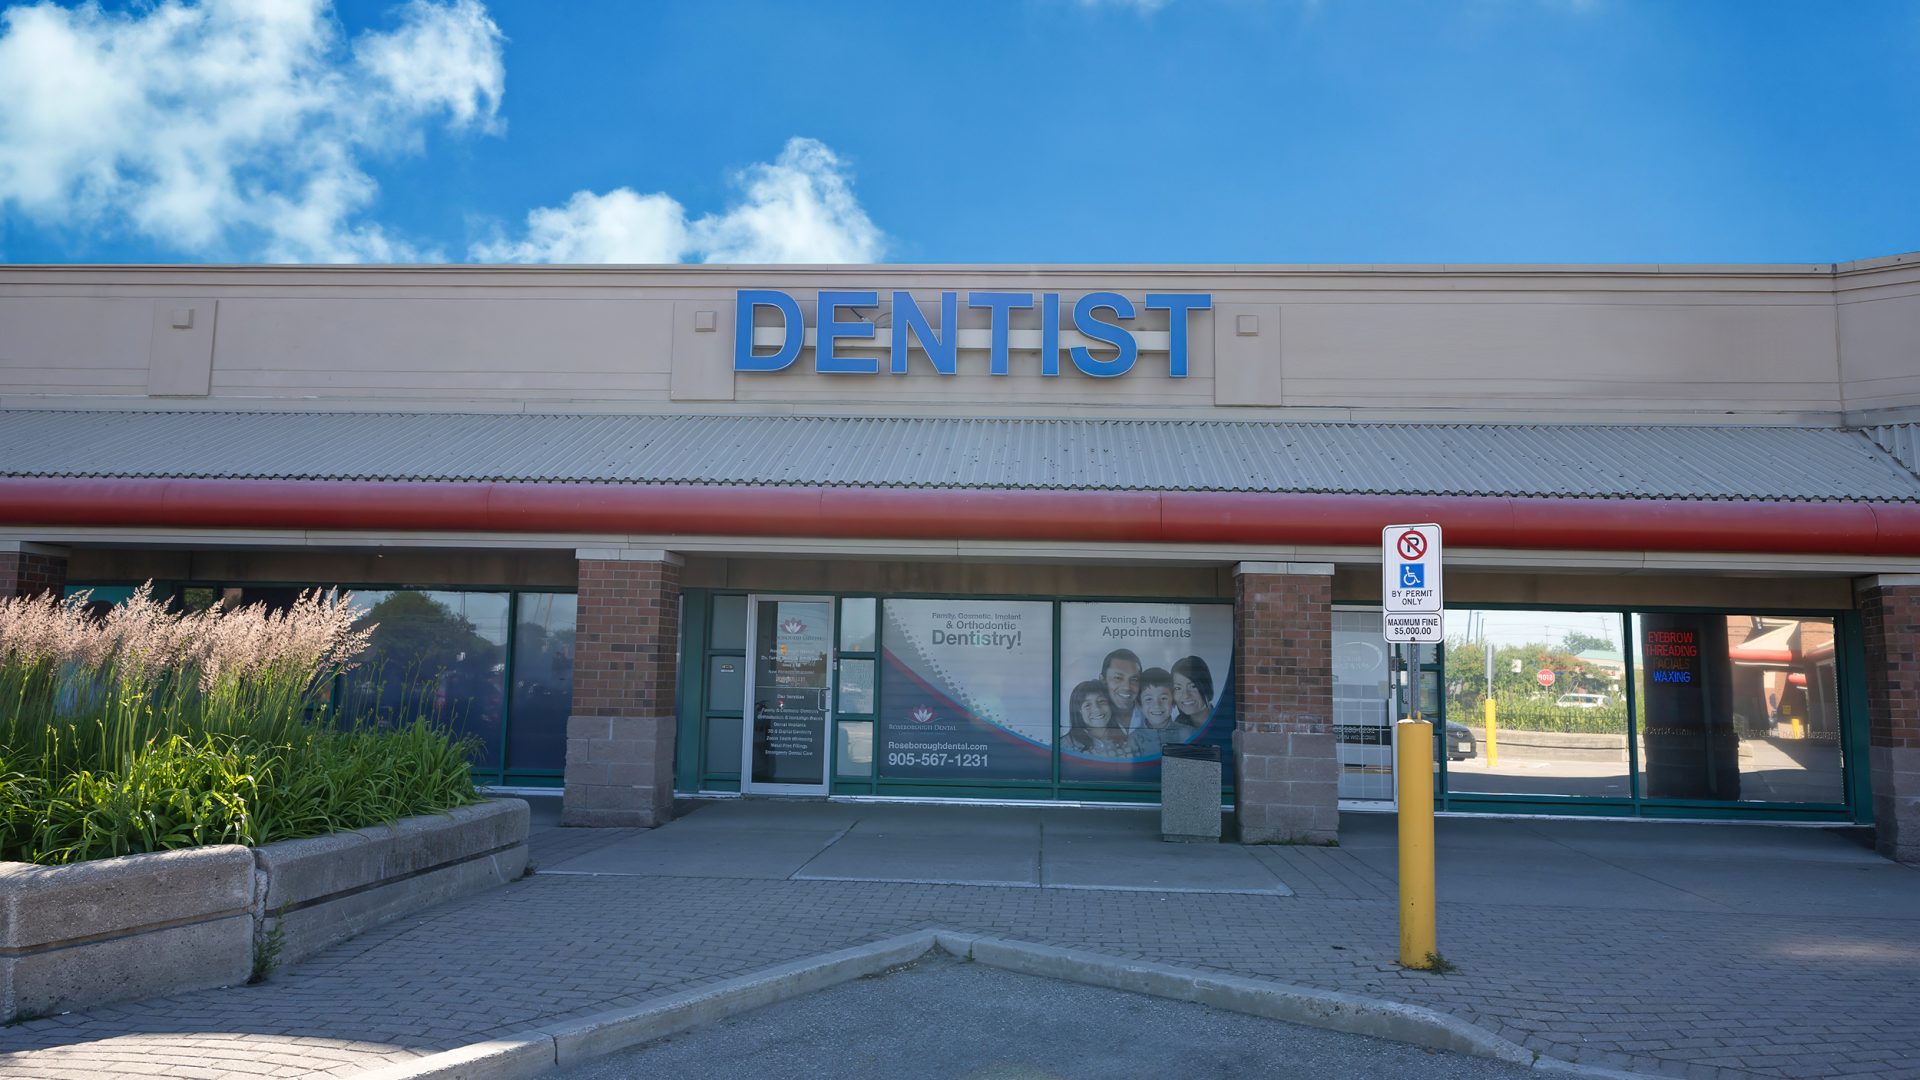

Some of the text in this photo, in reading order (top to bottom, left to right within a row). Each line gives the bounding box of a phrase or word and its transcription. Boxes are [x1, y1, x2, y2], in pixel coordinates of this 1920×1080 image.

[734, 289, 1213, 378] DENTIST
[994, 613, 1021, 621] Implant
[1100, 615, 1191, 626] Evening & Weekend
[1387, 618, 1438, 626] MAXIMUM FINE
[945, 620, 1017, 630] & Orthodontic
[1102, 626, 1191, 639] Appointments
[1648, 631, 1693, 643] EYEBROW
[931, 629, 1022, 650] Dentistry!
[1643, 643, 1697, 656] THREADING
[1653, 671, 1691, 682] WAXING
[888, 741, 988, 751] Roseboroughdental.com
[888, 752, 988, 767] 905-567-1231
